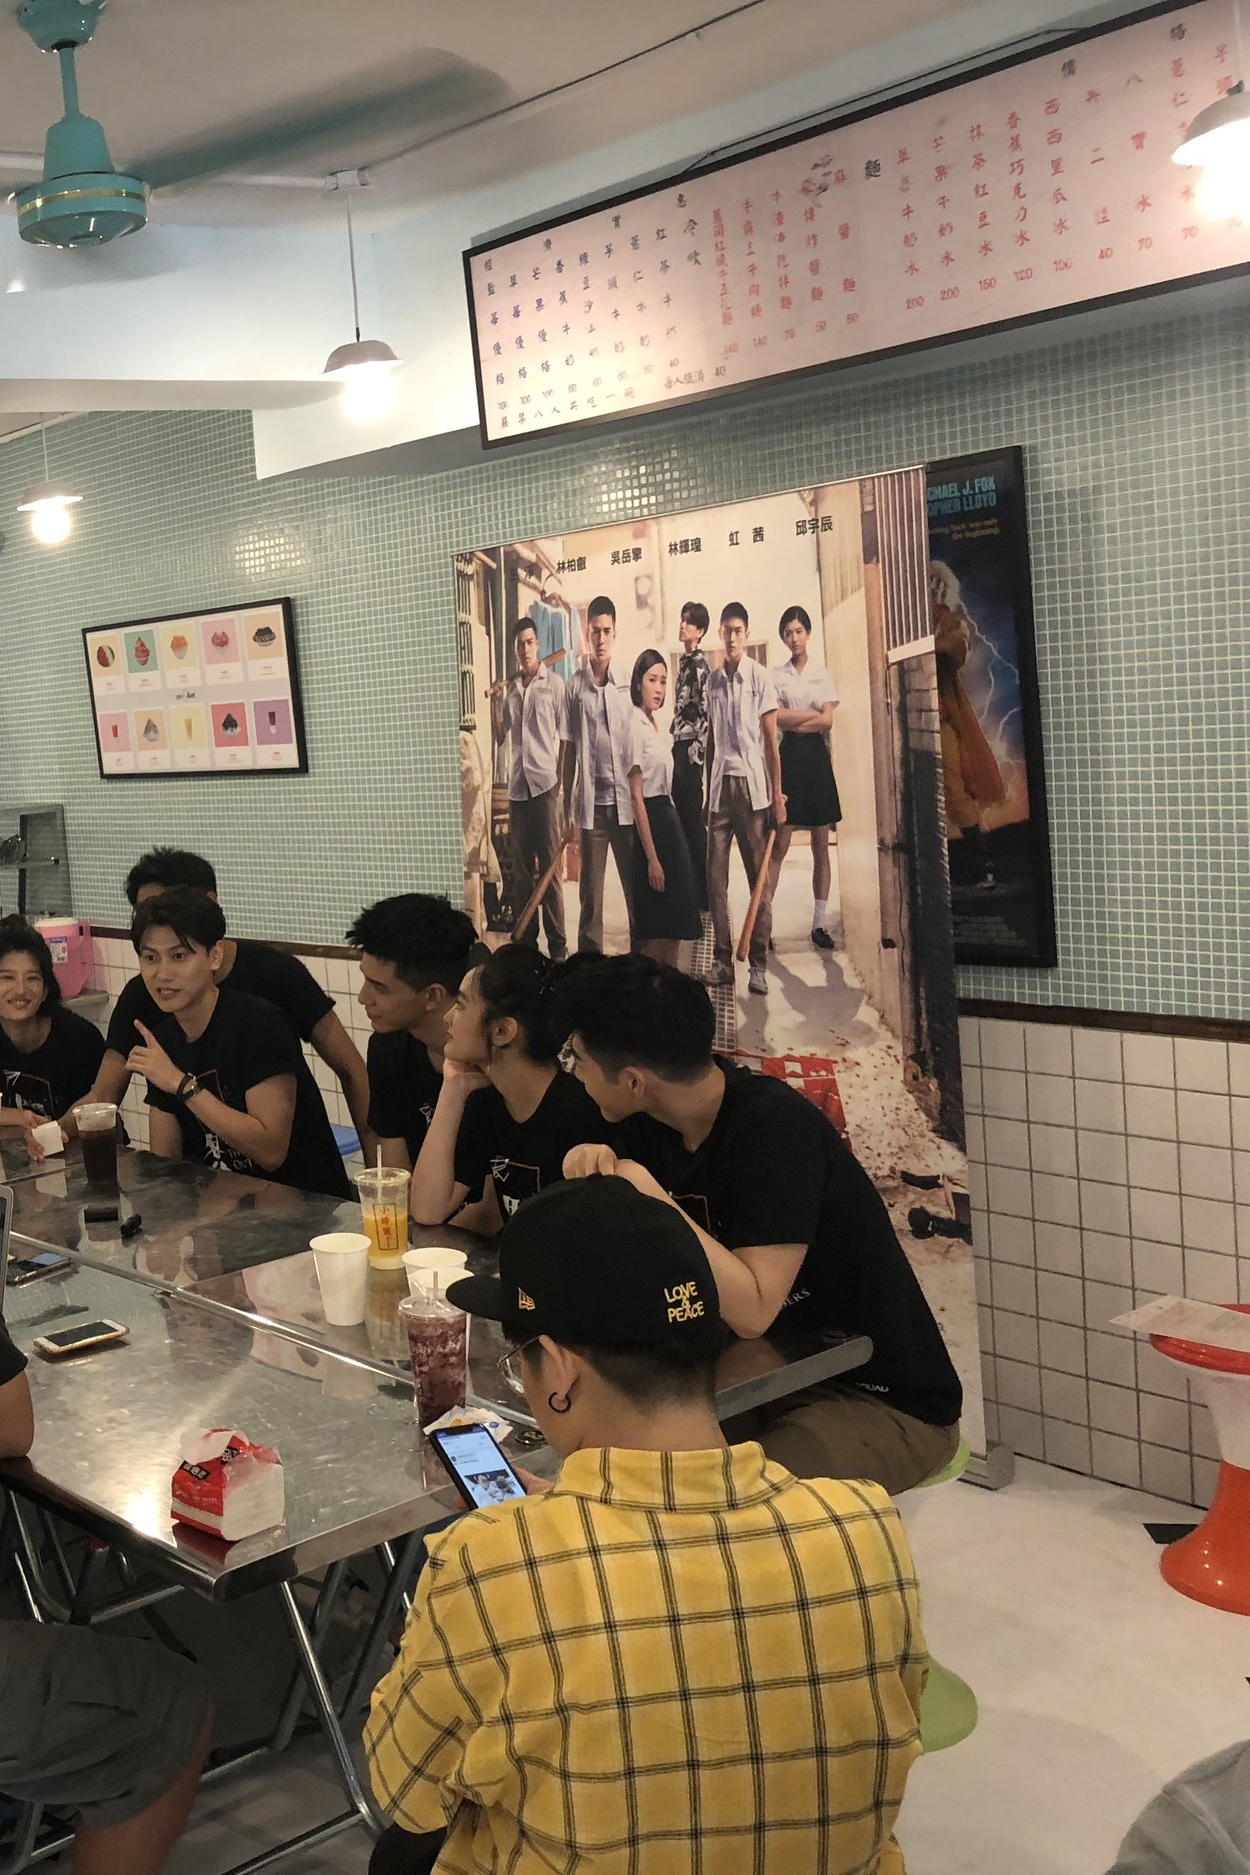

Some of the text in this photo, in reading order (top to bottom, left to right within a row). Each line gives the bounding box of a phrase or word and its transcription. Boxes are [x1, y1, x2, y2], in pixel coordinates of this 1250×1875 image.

[1138, 237, 1153, 250] 70
[1098, 247, 1113, 260] 40
[1014, 268, 1033, 281] 120
[978, 277, 996, 290] 150
[940, 287, 959, 301] 200
[906, 296, 925, 310] 200
[963, 480, 973, 495] J.
[974, 476, 996, 493] FOX
[963, 492, 997, 511] LLOYD
[795, 515, 834, 536] 邱宇辰
[664, 1281, 698, 1303] LOVE
[667, 1301, 704, 1323] PEACE
